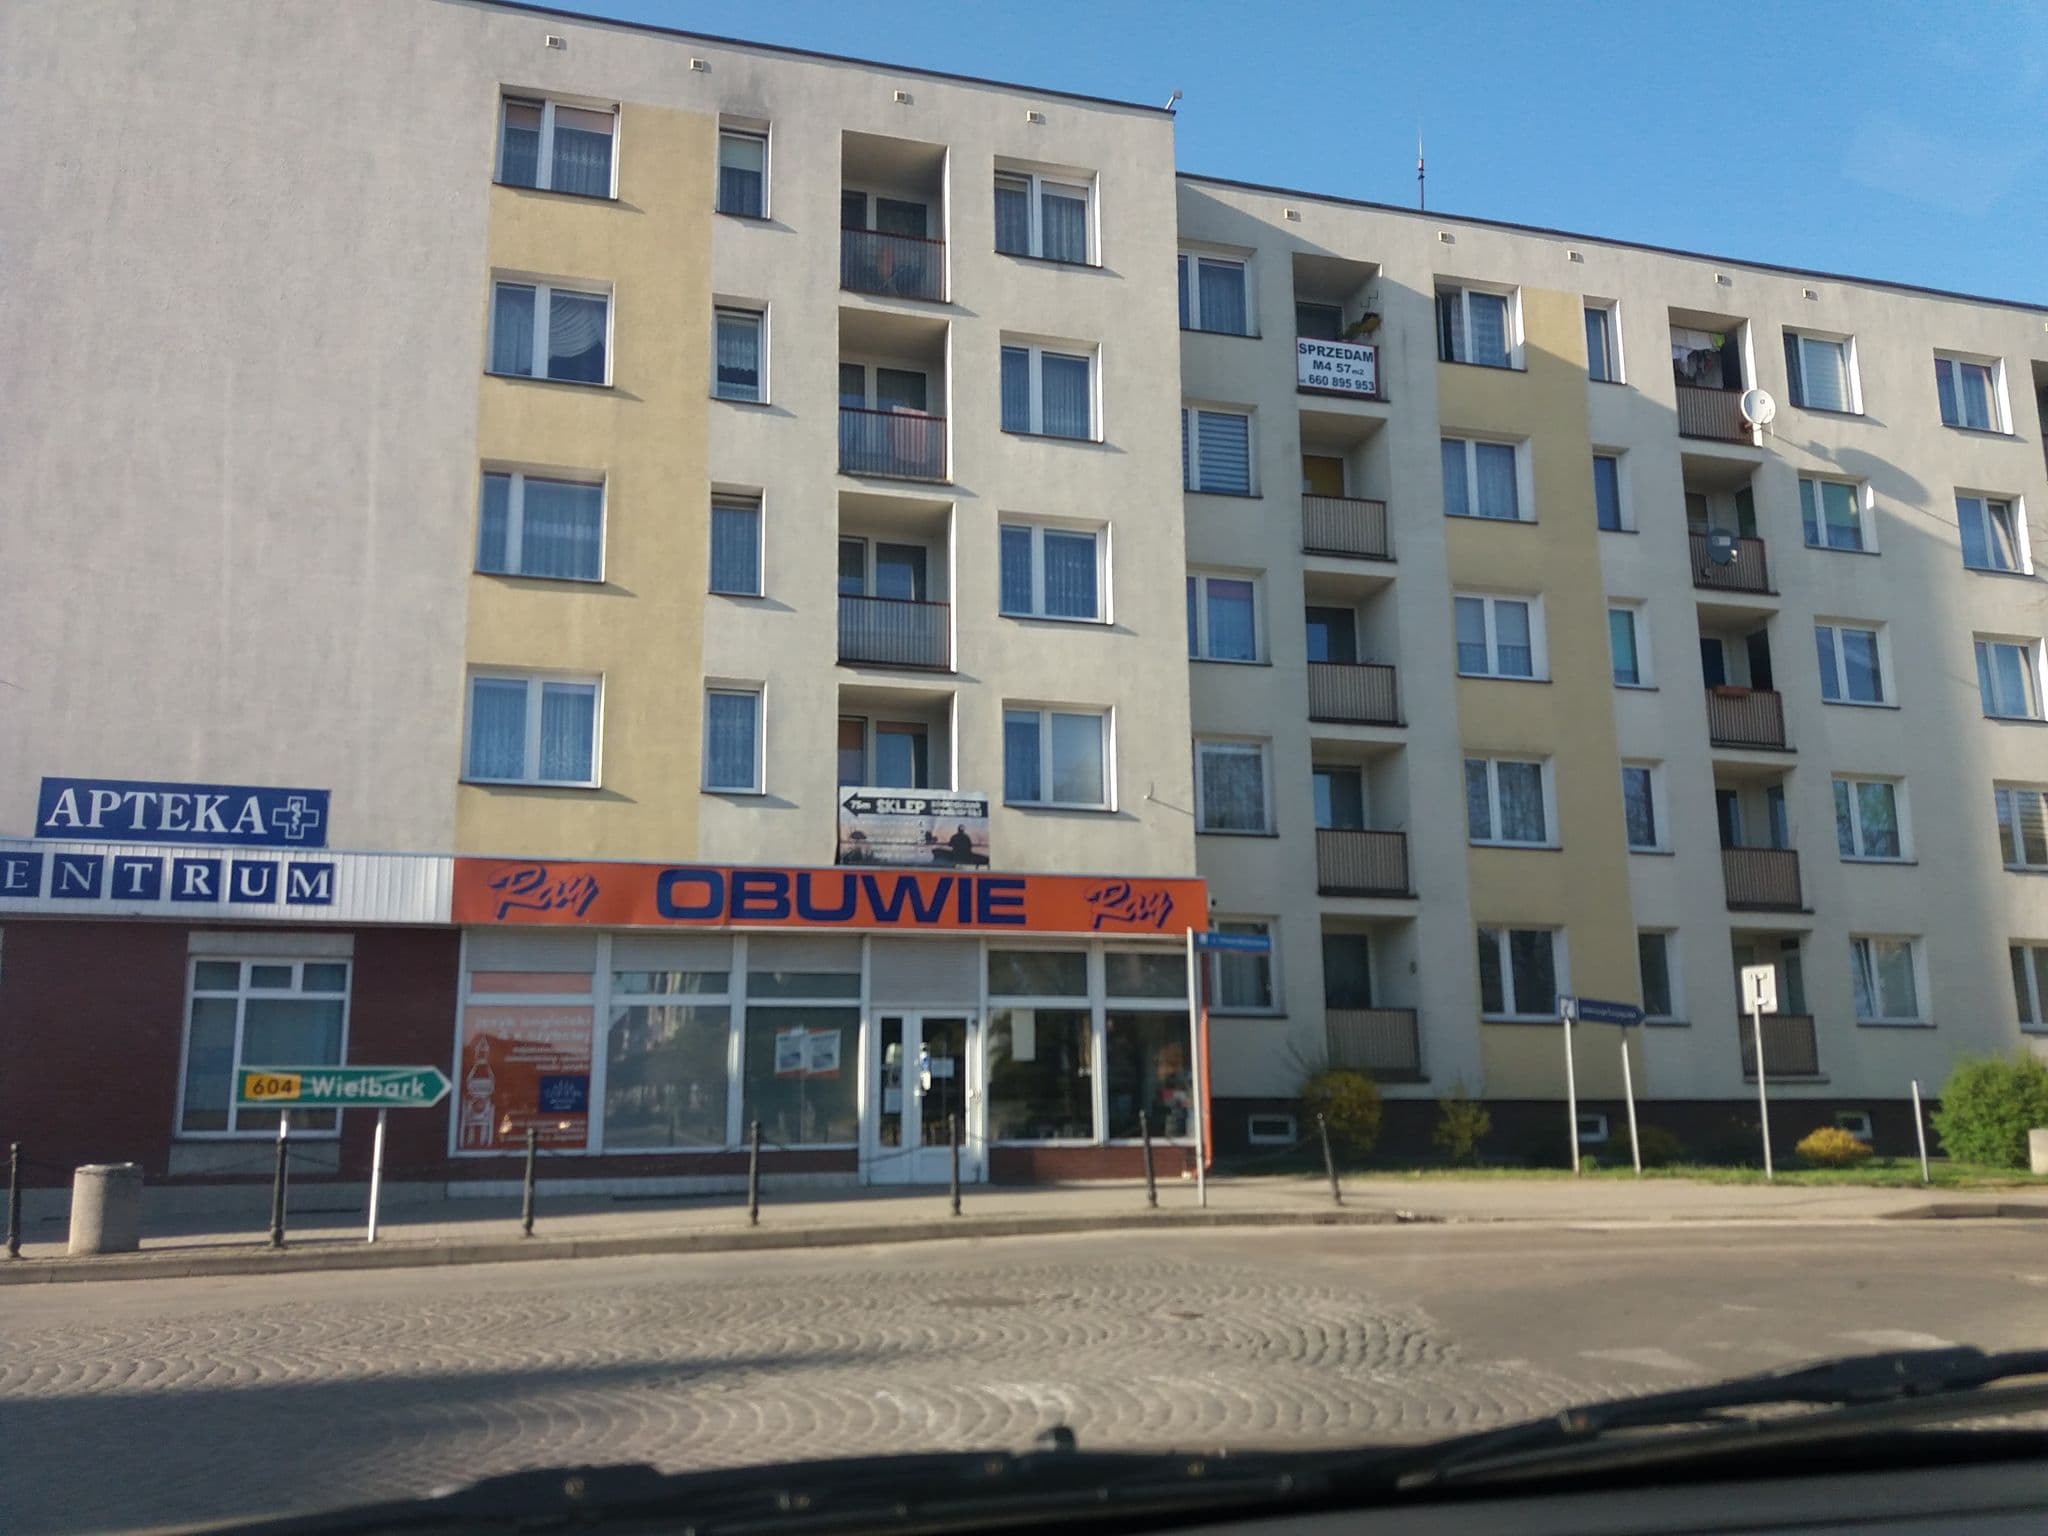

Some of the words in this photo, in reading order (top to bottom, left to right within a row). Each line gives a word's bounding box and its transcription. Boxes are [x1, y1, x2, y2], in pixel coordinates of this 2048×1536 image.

[1299, 343, 1374, 363] SPRZEDAM
[1313, 360, 1332, 371] M4
[1336, 363, 1352, 373] 57
[1309, 374, 1329, 386] 660
[1332, 377, 1352, 388] 895
[1355, 380, 1375, 391] 953
[43, 787, 268, 835] APTEKA
[876, 798, 926, 814] SKLEP
[656, 868, 1027, 926] OBUWIE
[252, 1078, 294, 1095] 604
[310, 1076, 426, 1098] Wielbark
